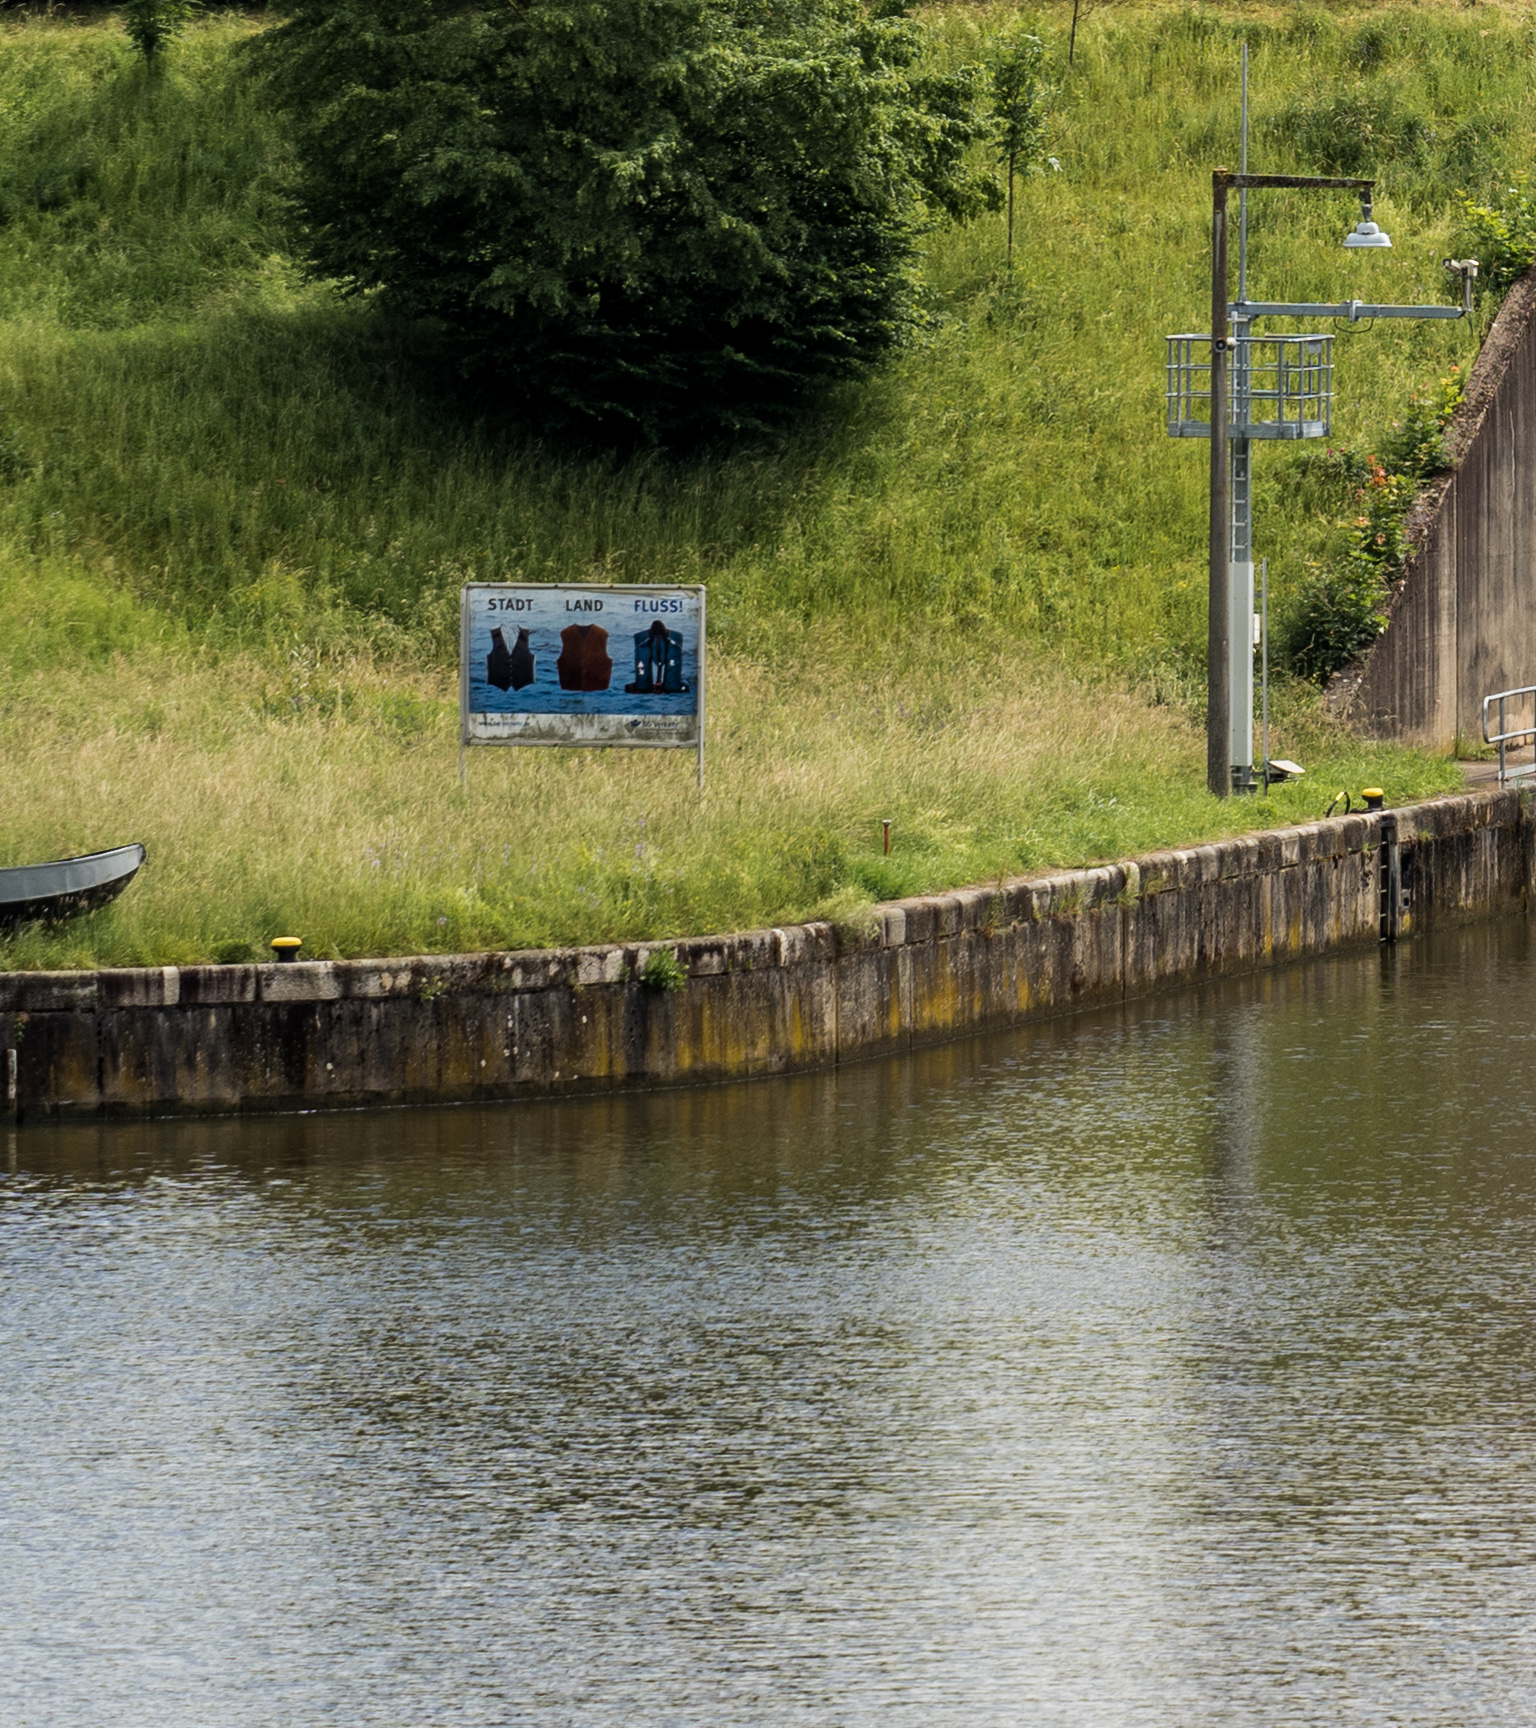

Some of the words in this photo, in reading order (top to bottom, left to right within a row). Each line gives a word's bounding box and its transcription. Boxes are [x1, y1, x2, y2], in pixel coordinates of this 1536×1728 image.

[488, 598, 534, 611] STADT
[565, 599, 604, 612] LAND
[634, 600, 683, 613] FLUSS!
